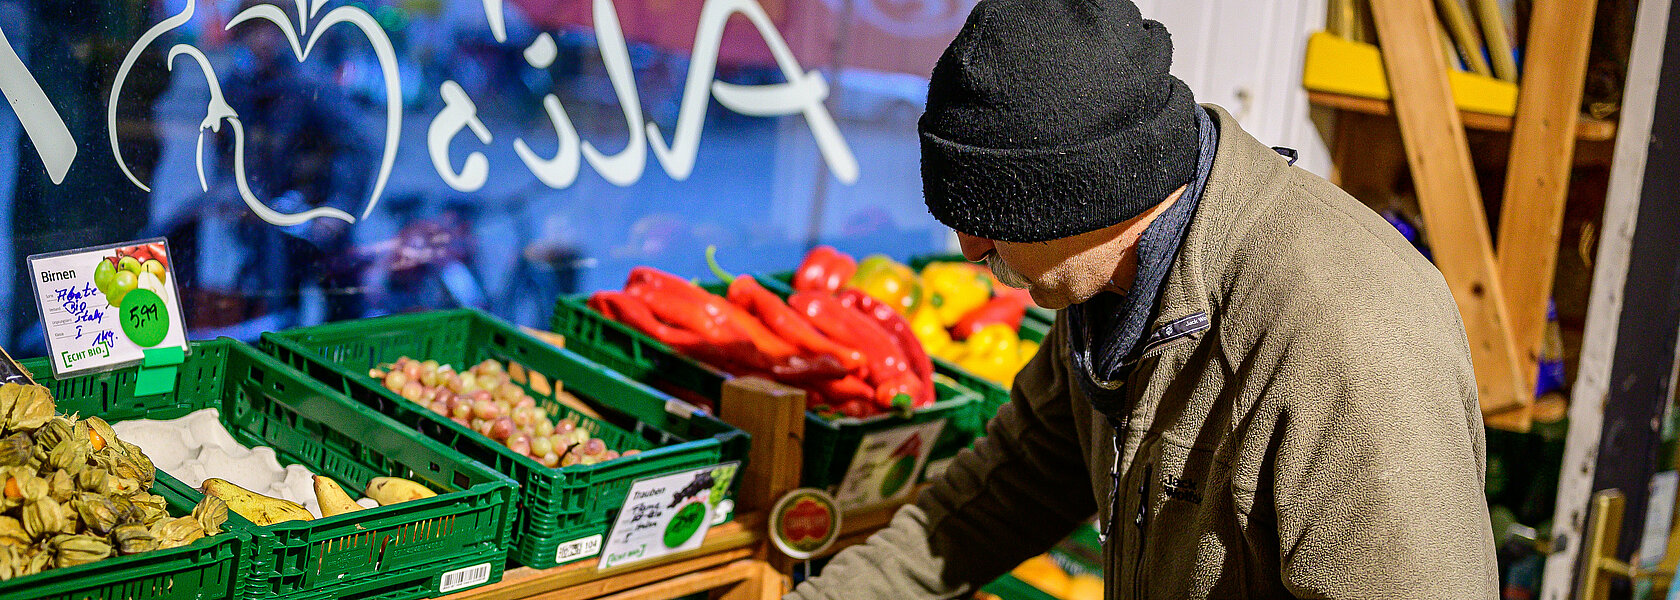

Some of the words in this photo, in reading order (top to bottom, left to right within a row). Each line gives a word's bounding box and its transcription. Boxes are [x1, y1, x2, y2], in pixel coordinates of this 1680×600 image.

[41, 269, 76, 283] Birnen
[55, 282, 97, 302] Abate
[74, 308, 104, 325] Italy
[129, 302, 158, 328] 5,99
[1185, 318, 1198, 327] Jack
[633, 487, 666, 500] Trauben
